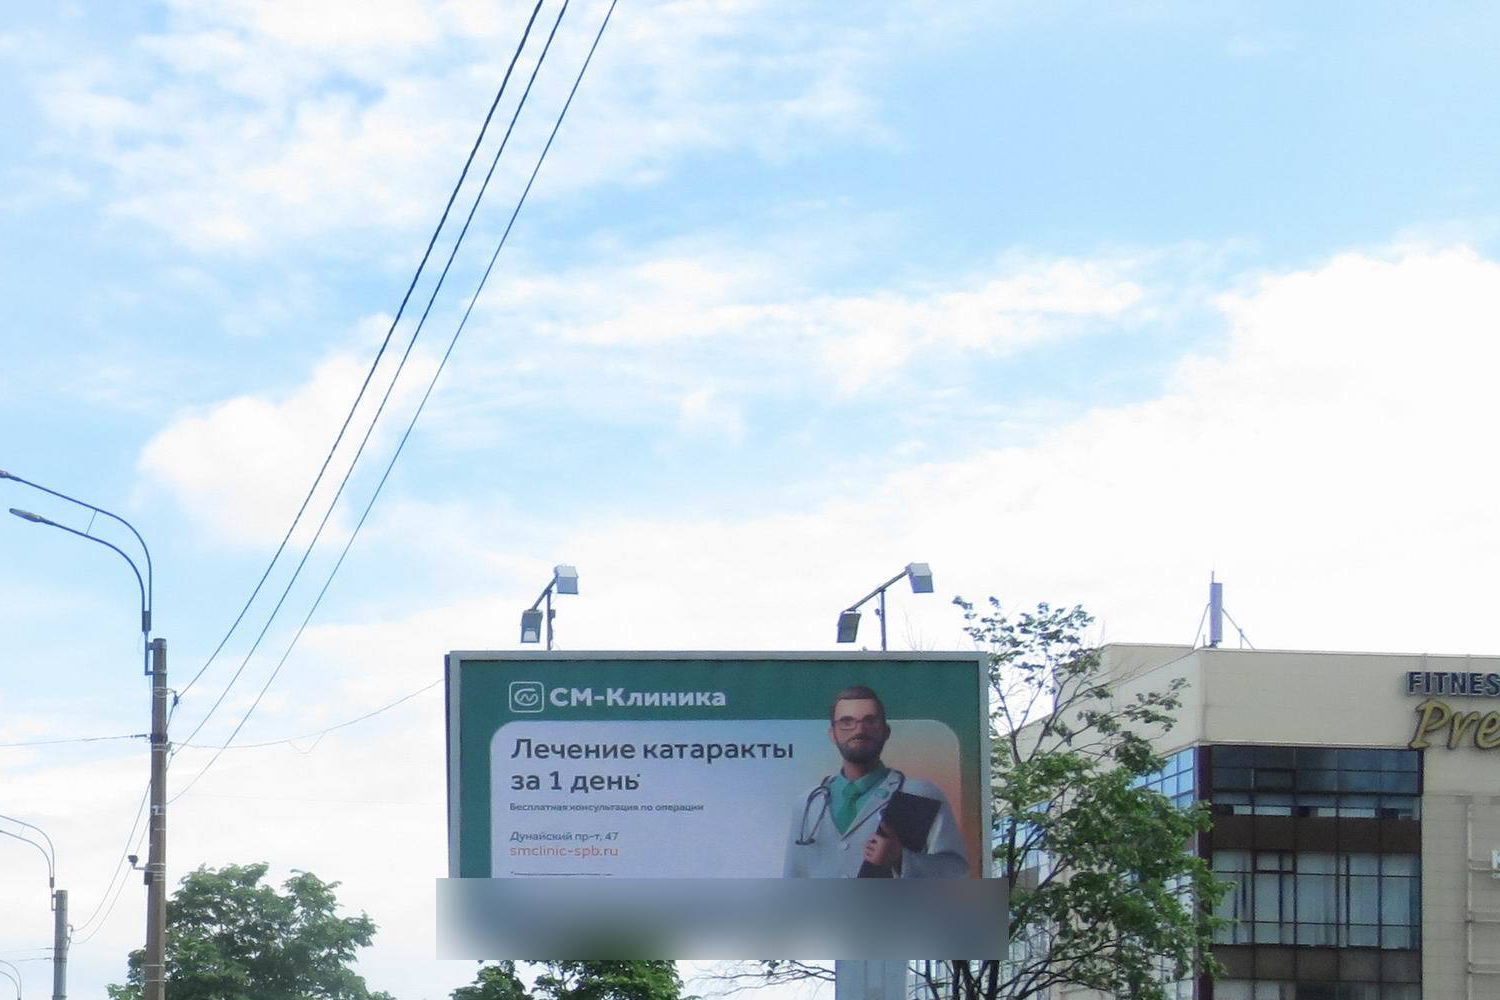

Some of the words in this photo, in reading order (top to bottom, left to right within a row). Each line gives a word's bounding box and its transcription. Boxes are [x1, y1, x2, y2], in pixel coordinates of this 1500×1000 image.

[1406, 672, 1500, 696] FITNES
[550, 687, 726, 707] СМ-Клиника
[1408, 698, 1500, 750] Pre
[510, 738, 636, 760] Лечение
[643, 742, 794, 764] катаракты
[510, 774, 540, 791] за
[550, 771, 562, 790] 1
[510, 803, 568, 812] Бесплатная
[569, 804, 639, 813] консультация
[640, 804, 653, 812] по
[655, 804, 704, 813] операции
[510, 831, 573, 843] Дунайский
[605, 832, 619, 841] 47
[510, 845, 619, 858] smclinic-spb.ru
